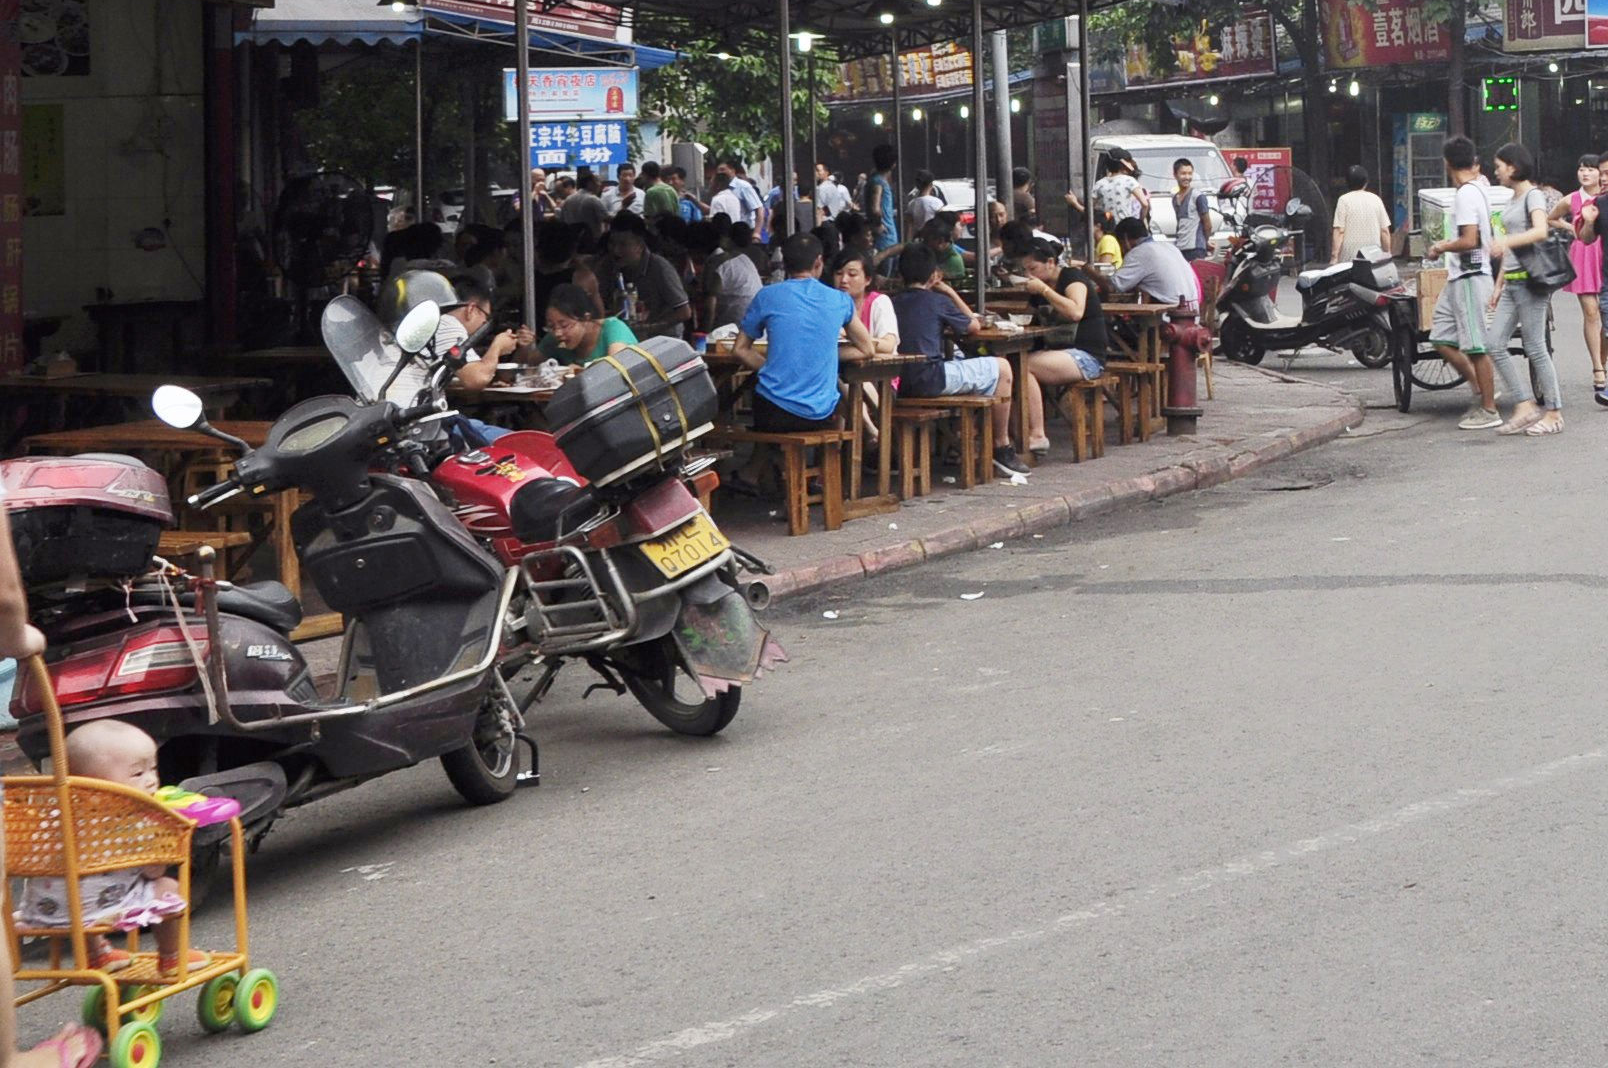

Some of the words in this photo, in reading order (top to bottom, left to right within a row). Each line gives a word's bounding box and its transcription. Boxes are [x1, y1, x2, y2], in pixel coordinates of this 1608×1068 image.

[514, 74, 596, 88] 天香宵夜店
